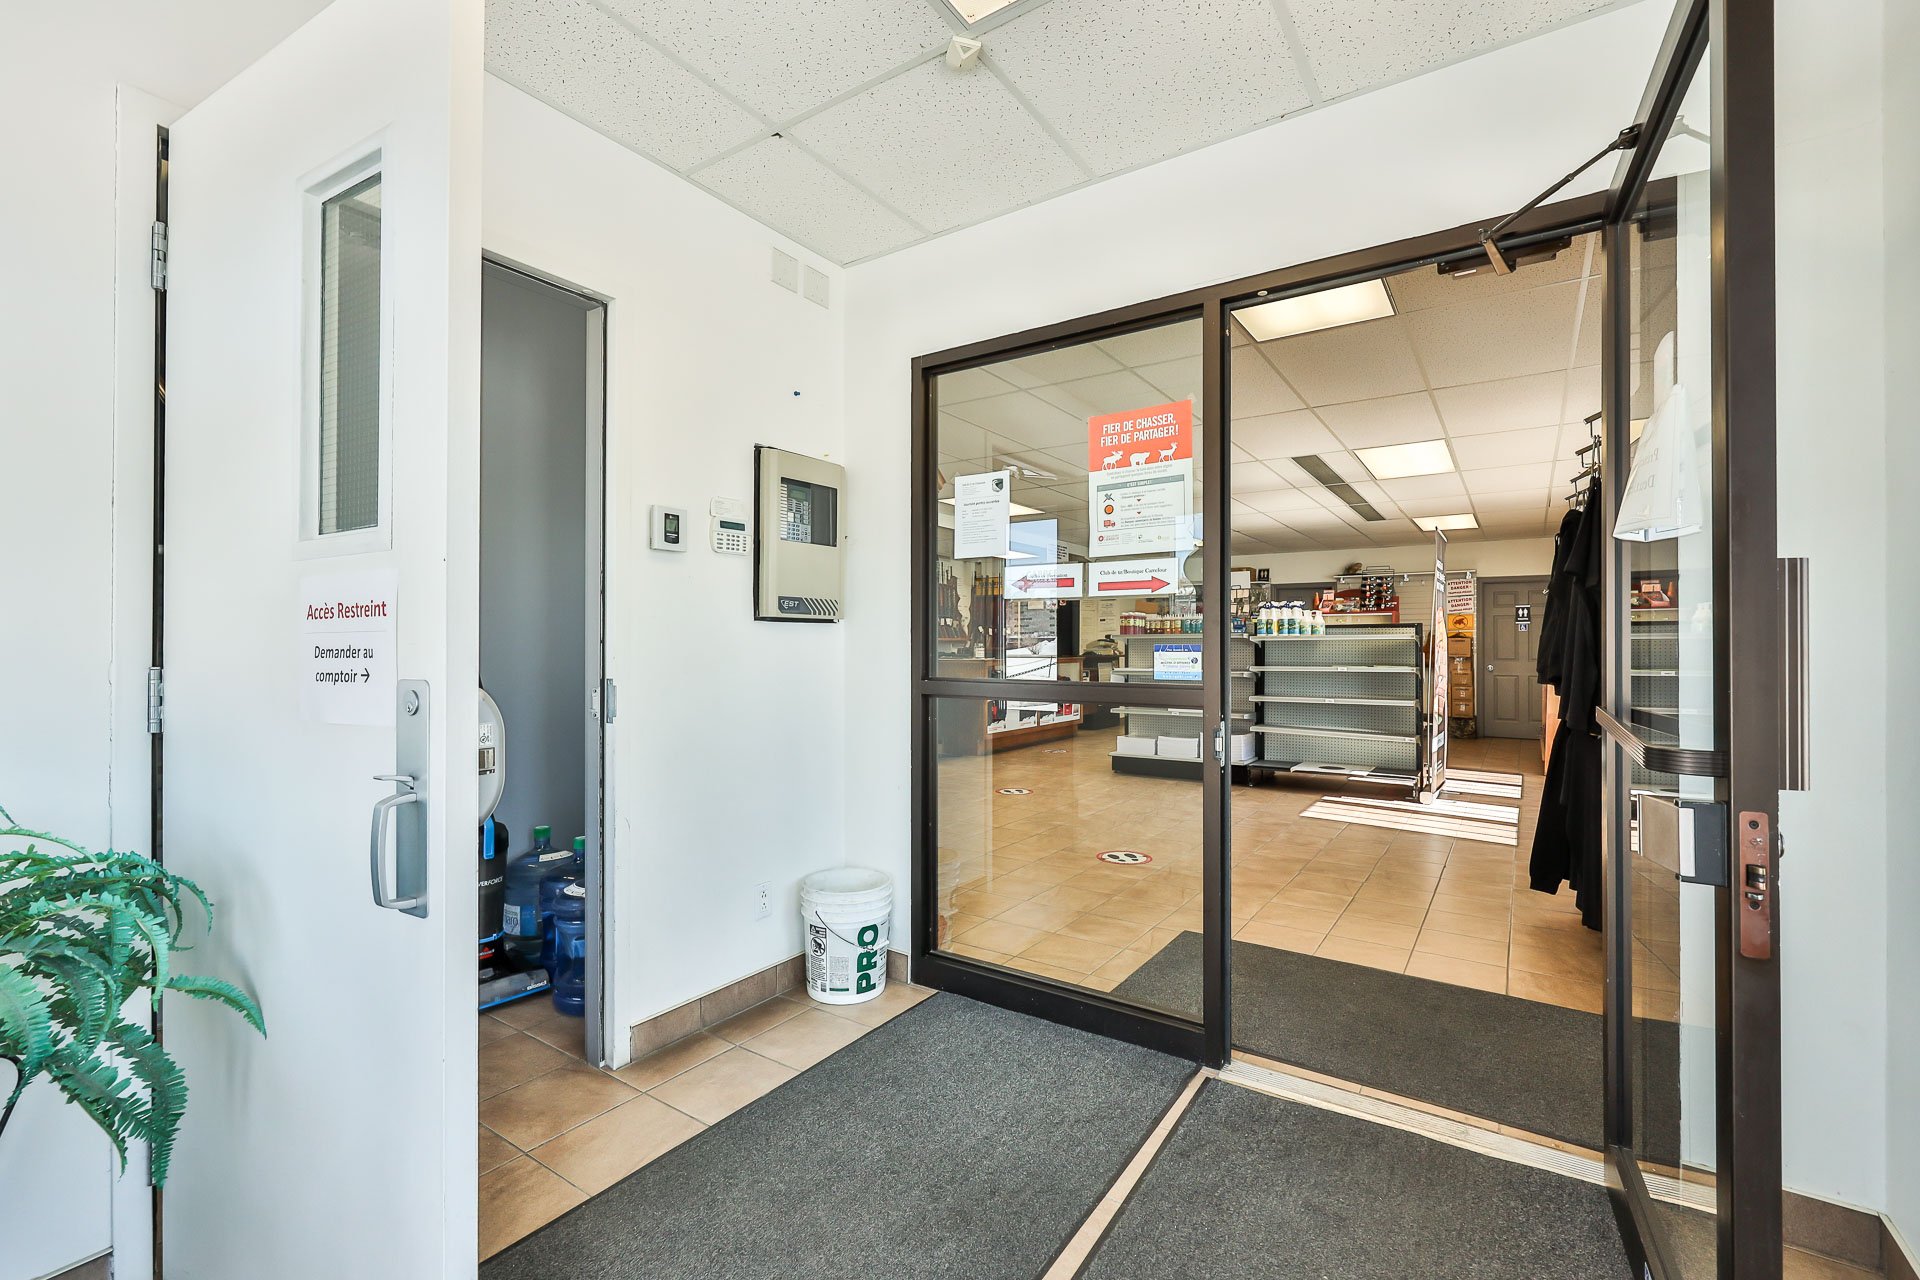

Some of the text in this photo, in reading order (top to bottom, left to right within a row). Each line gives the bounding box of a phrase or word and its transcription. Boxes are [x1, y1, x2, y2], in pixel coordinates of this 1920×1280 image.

[1103, 413, 1176, 435] FIER DE CHASSER,
[1100, 435, 1119, 448] FIER
[1121, 433, 1132, 444] DE
[306, 599, 387, 620] Accès Restreint
[314, 644, 374, 659] Demander au
[315, 668, 358, 686] comptoir
[856, 923, 879, 995] PRO
